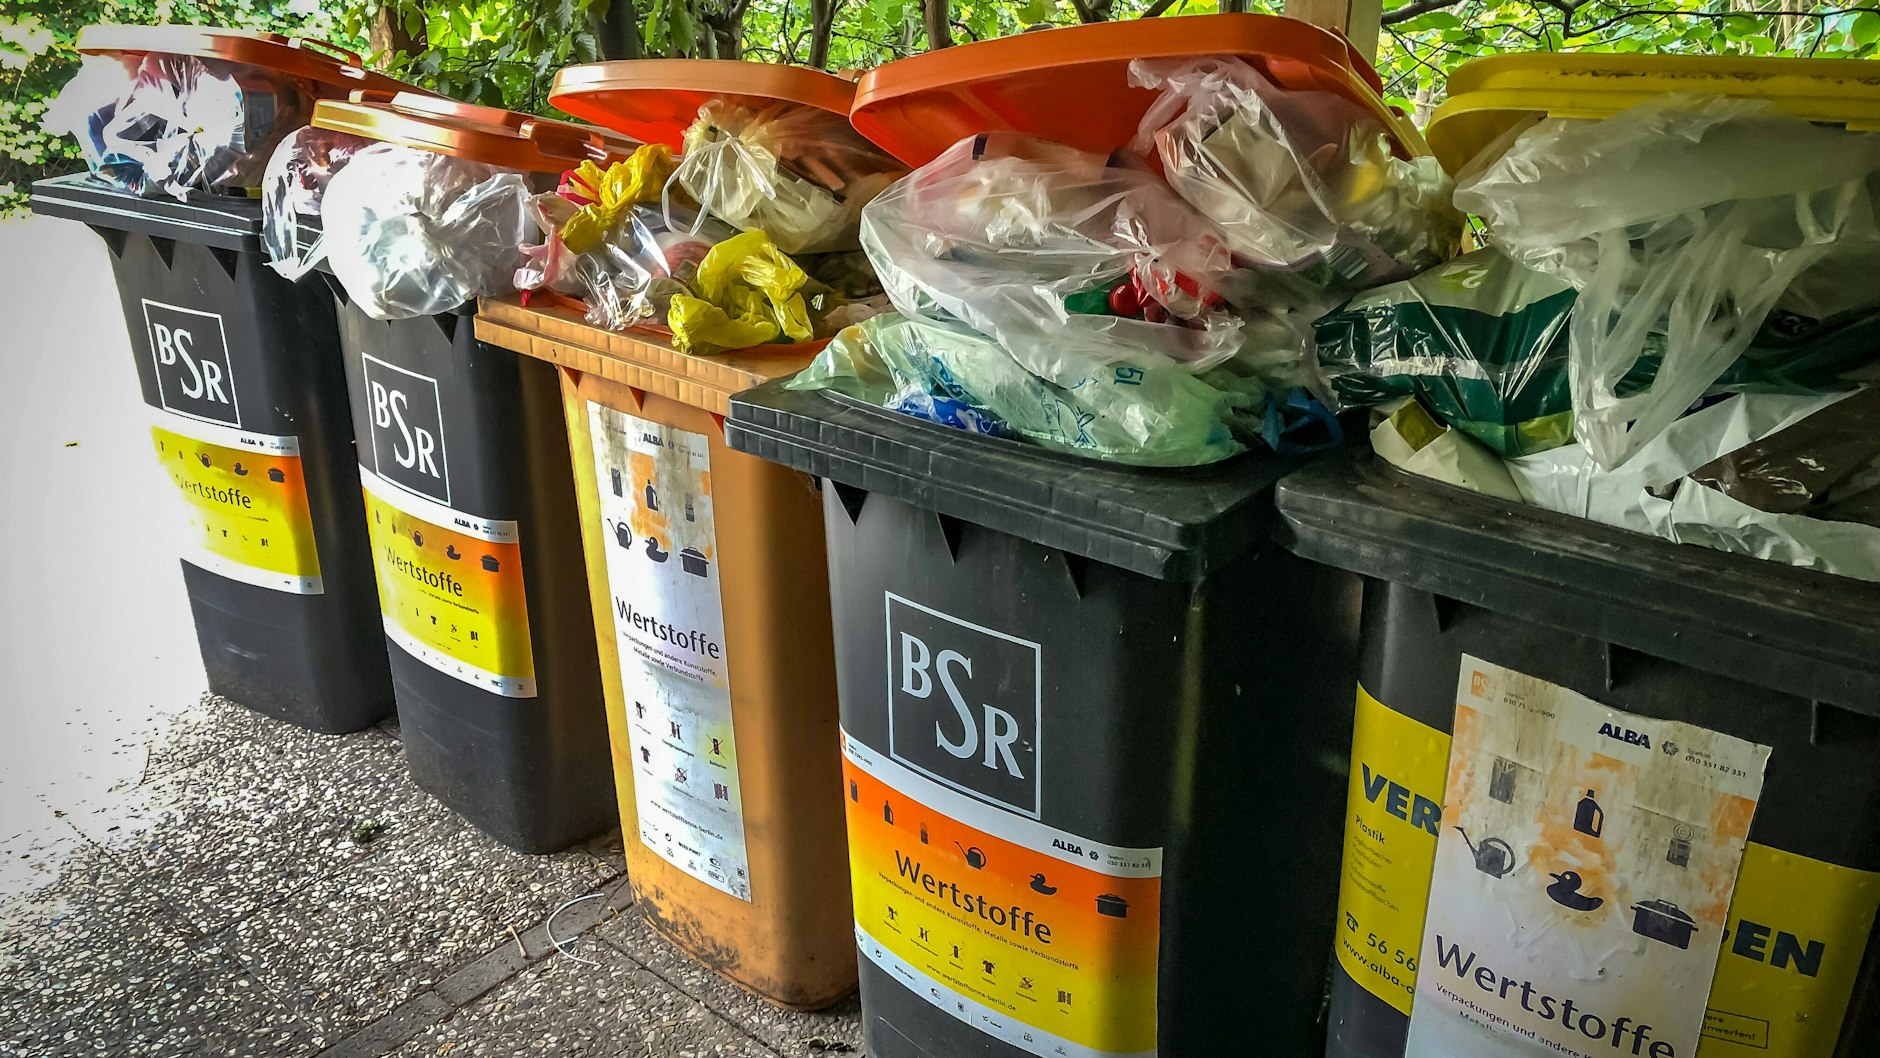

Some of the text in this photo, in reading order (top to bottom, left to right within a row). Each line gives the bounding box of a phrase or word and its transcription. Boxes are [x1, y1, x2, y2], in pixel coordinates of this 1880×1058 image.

[154, 322, 230, 404] BSR
[371, 380, 440, 479] BSR
[643, 432, 664, 448] ALBA
[176, 473, 252, 509] ertstoffe
[454, 517, 471, 529] ALBA
[384, 546, 464, 598] Wertstoffe
[616, 596, 720, 660] Wertstoffe
[900, 631, 1025, 780] BSR
[1598, 722, 1651, 750] ALBA
[1703, 759, 1717, 770] 351
[1720, 764, 1730, 772] 82
[1732, 768, 1747, 778] 351
[1052, 838, 1084, 856] ALBA
[1356, 814, 1386, 845] Plastik
[1362, 762, 1826, 978] VER EN
[895, 850, 1052, 944] Wertstoffe
[914, 893, 926, 905] und
[926, 900, 946, 916] andere
[946, 912, 982, 934] Kunststoffe,
[984, 929, 1008, 944] Metalle
[1008, 940, 1029, 952] sowie
[1030, 947, 1079, 971] Verbundstoffe
[1366, 932, 1417, 972] 56 56
[1436, 934, 1676, 1058] Wertstoffe
[1436, 982, 1580, 1058] Verpackungen und andere
[1702, 1024, 1756, 1041] inwerfen!
